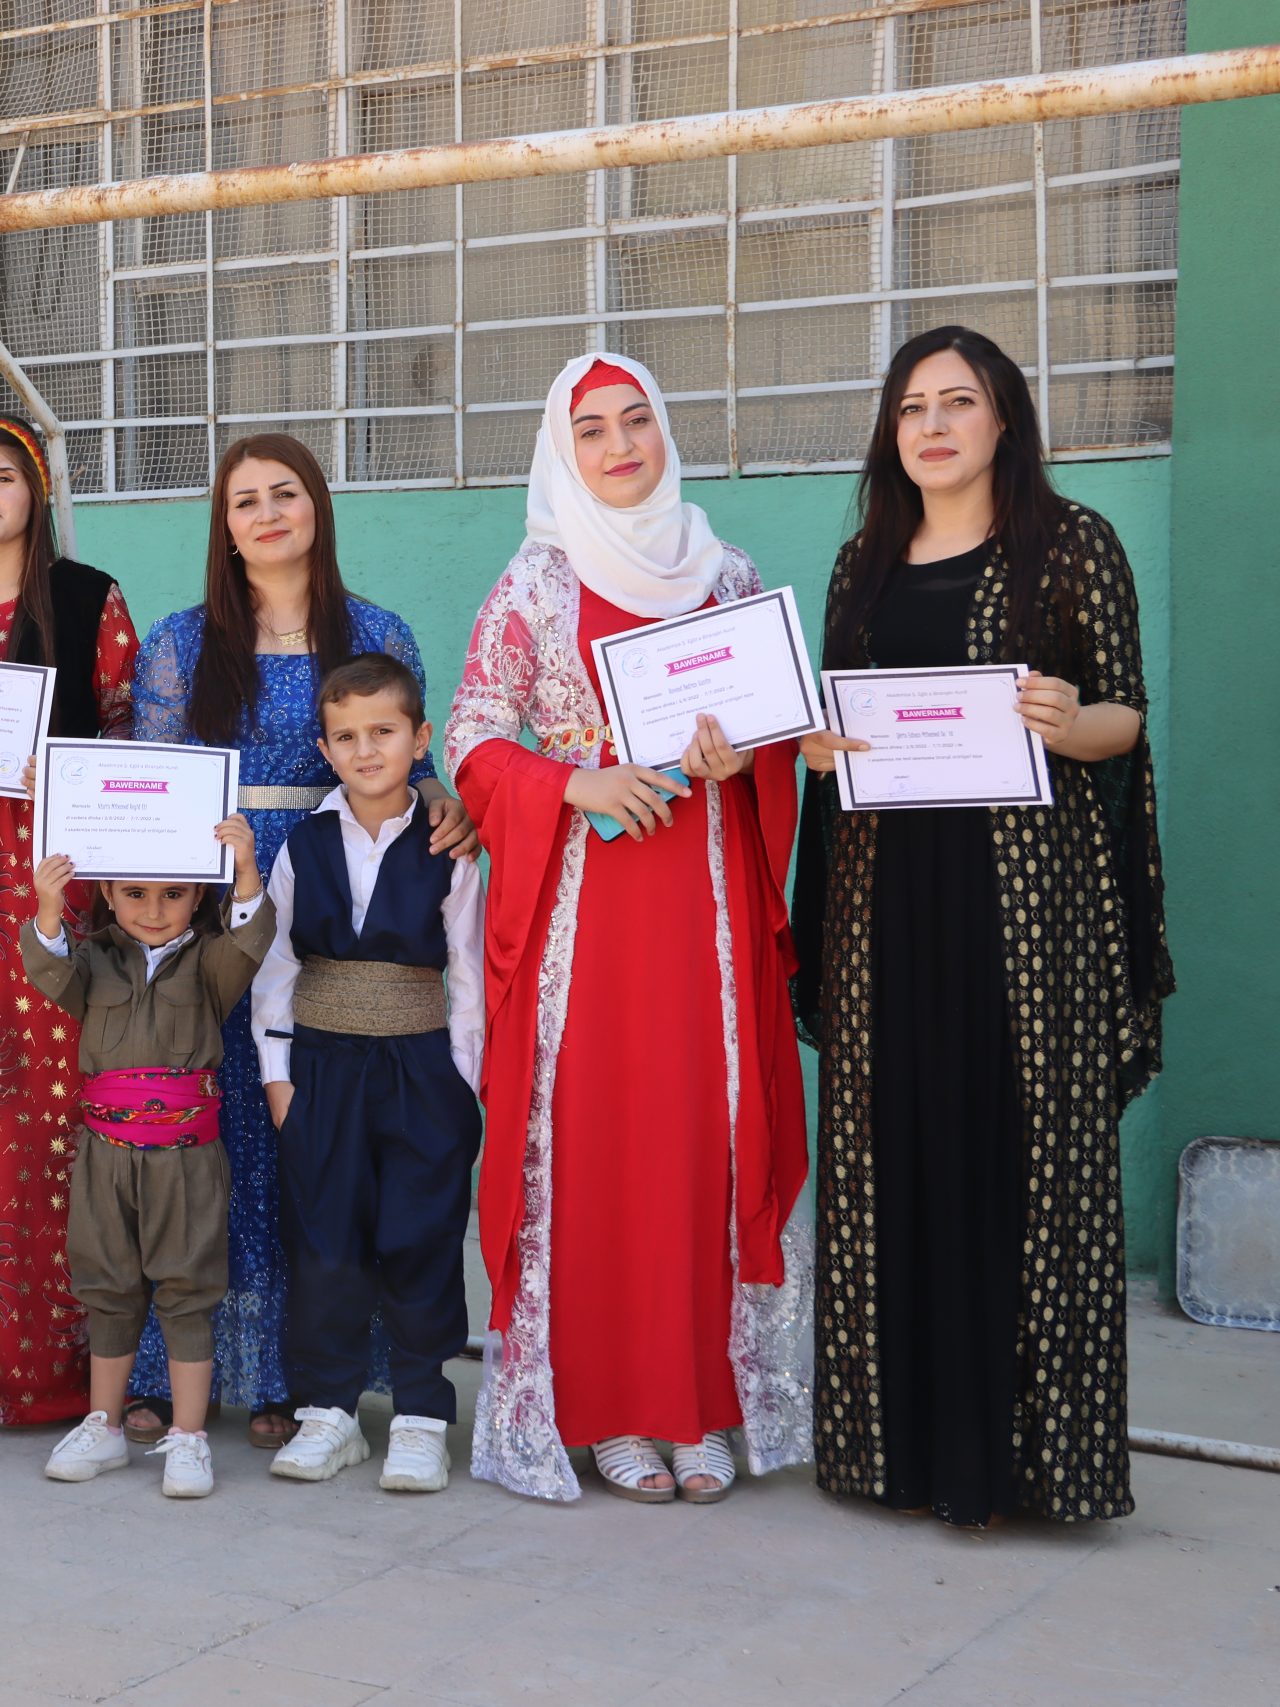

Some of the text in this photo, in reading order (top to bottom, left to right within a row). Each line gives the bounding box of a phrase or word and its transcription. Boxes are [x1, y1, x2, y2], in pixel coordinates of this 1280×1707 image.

[672, 648, 727, 671] BAWERNAME
[902, 708, 958, 718] BAWERNAME
[109, 781, 163, 790] BAWERNAME
